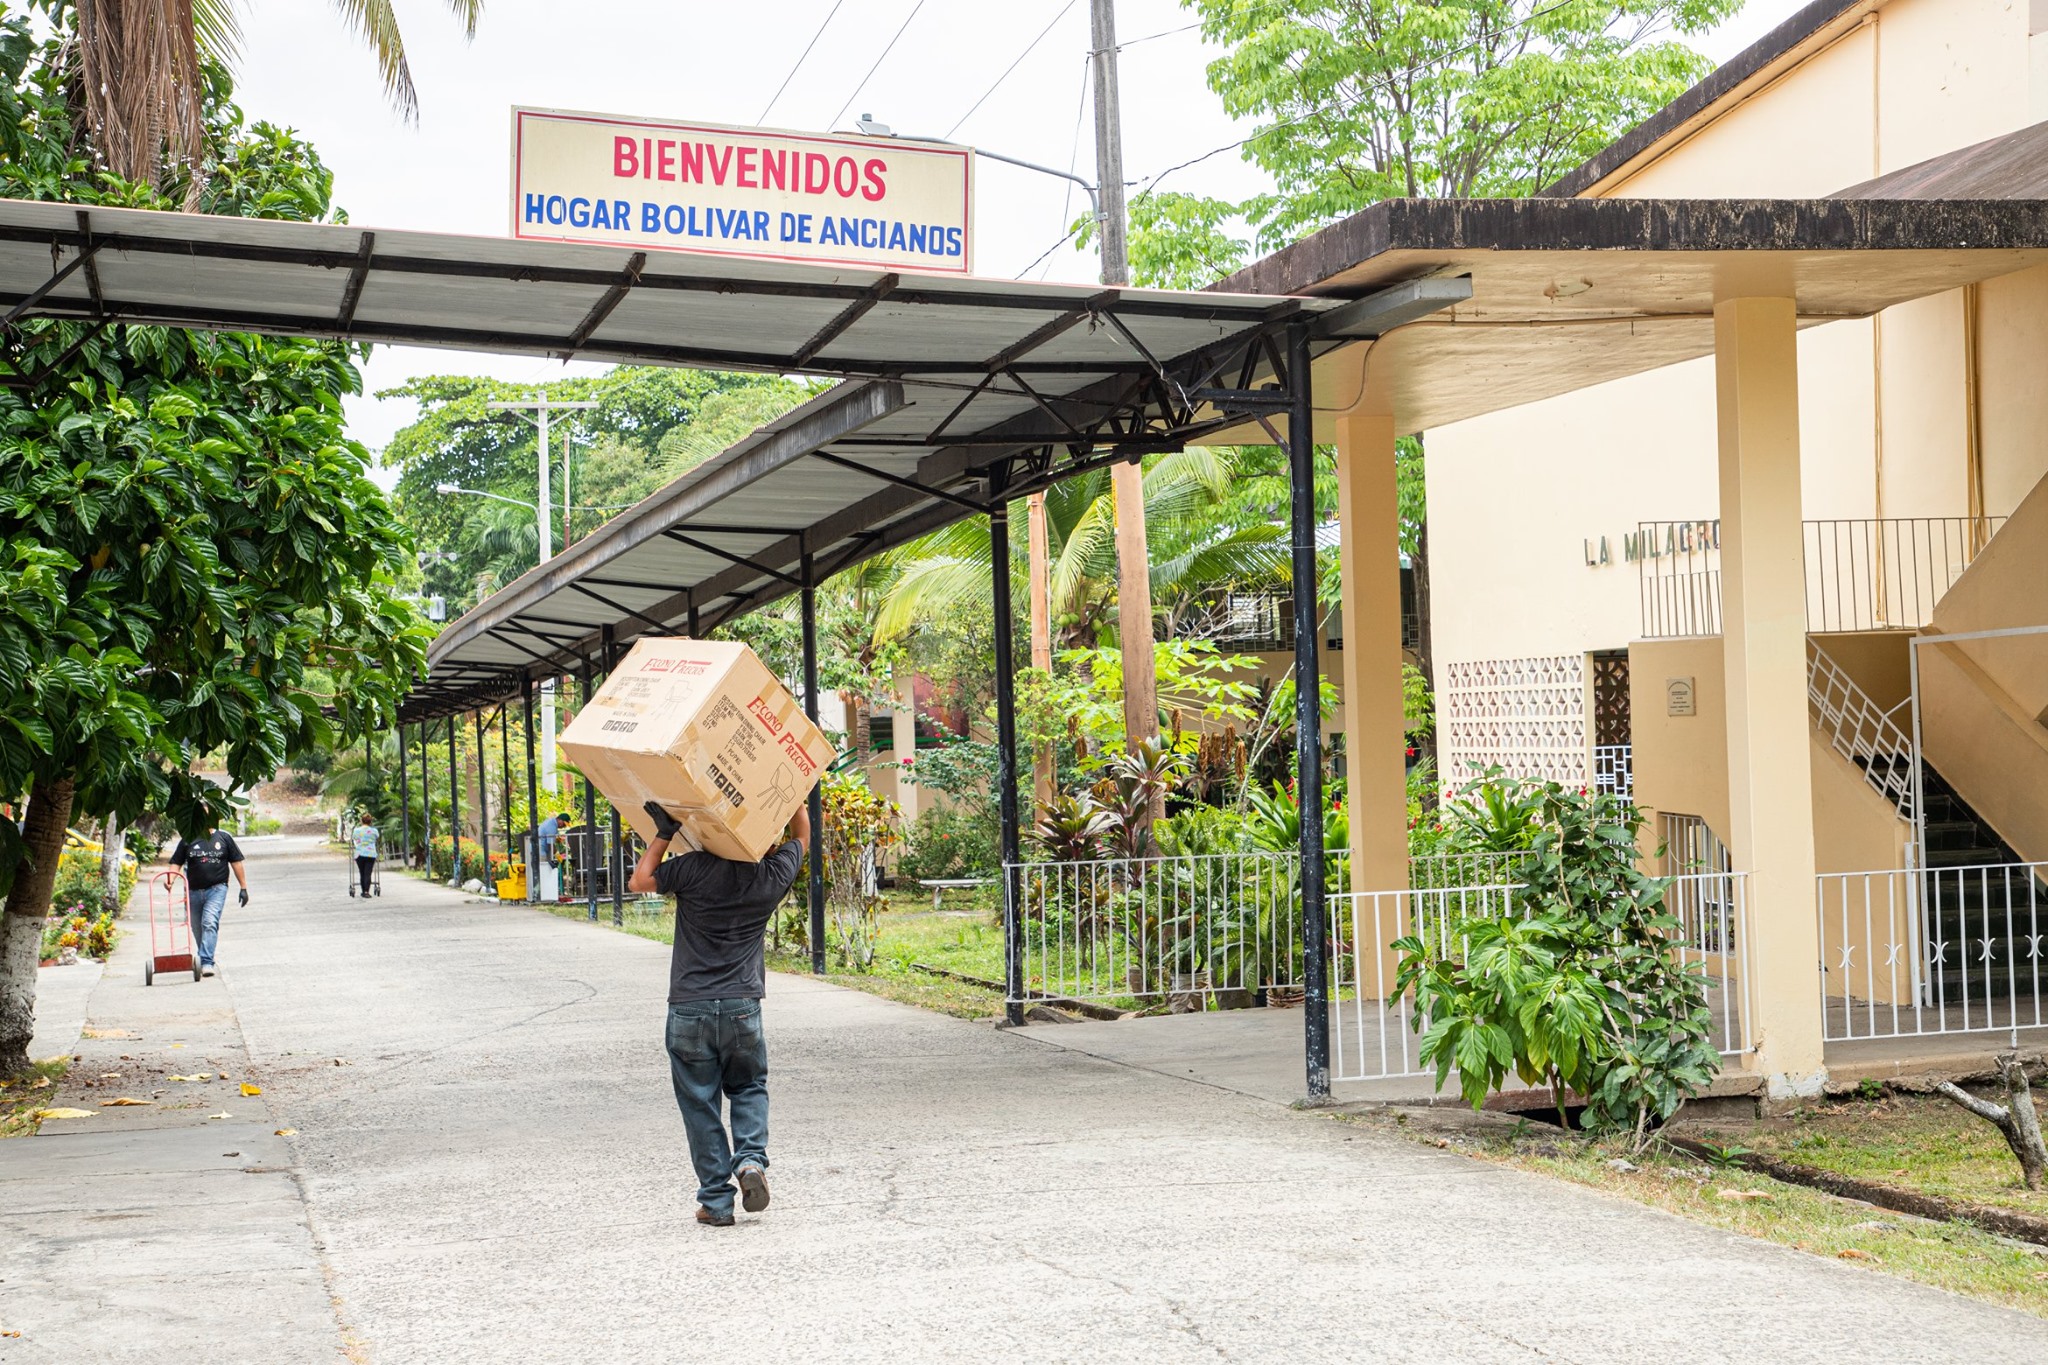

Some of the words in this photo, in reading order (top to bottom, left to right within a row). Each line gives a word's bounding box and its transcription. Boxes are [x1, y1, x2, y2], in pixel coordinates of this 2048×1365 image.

[613, 135, 888, 202] BIENVENIDOS
[525, 192, 631, 231] HOGAR
[641, 201, 770, 242] BOLIVAR
[779, 212, 812, 244] DE
[819, 216, 963, 257] ANCIANOS
[1584, 535, 1609, 566] LA
[640, 658, 676, 672] ECONO
[746, 696, 783, 736] ECONO
[778, 731, 817, 777] PRECIOS
